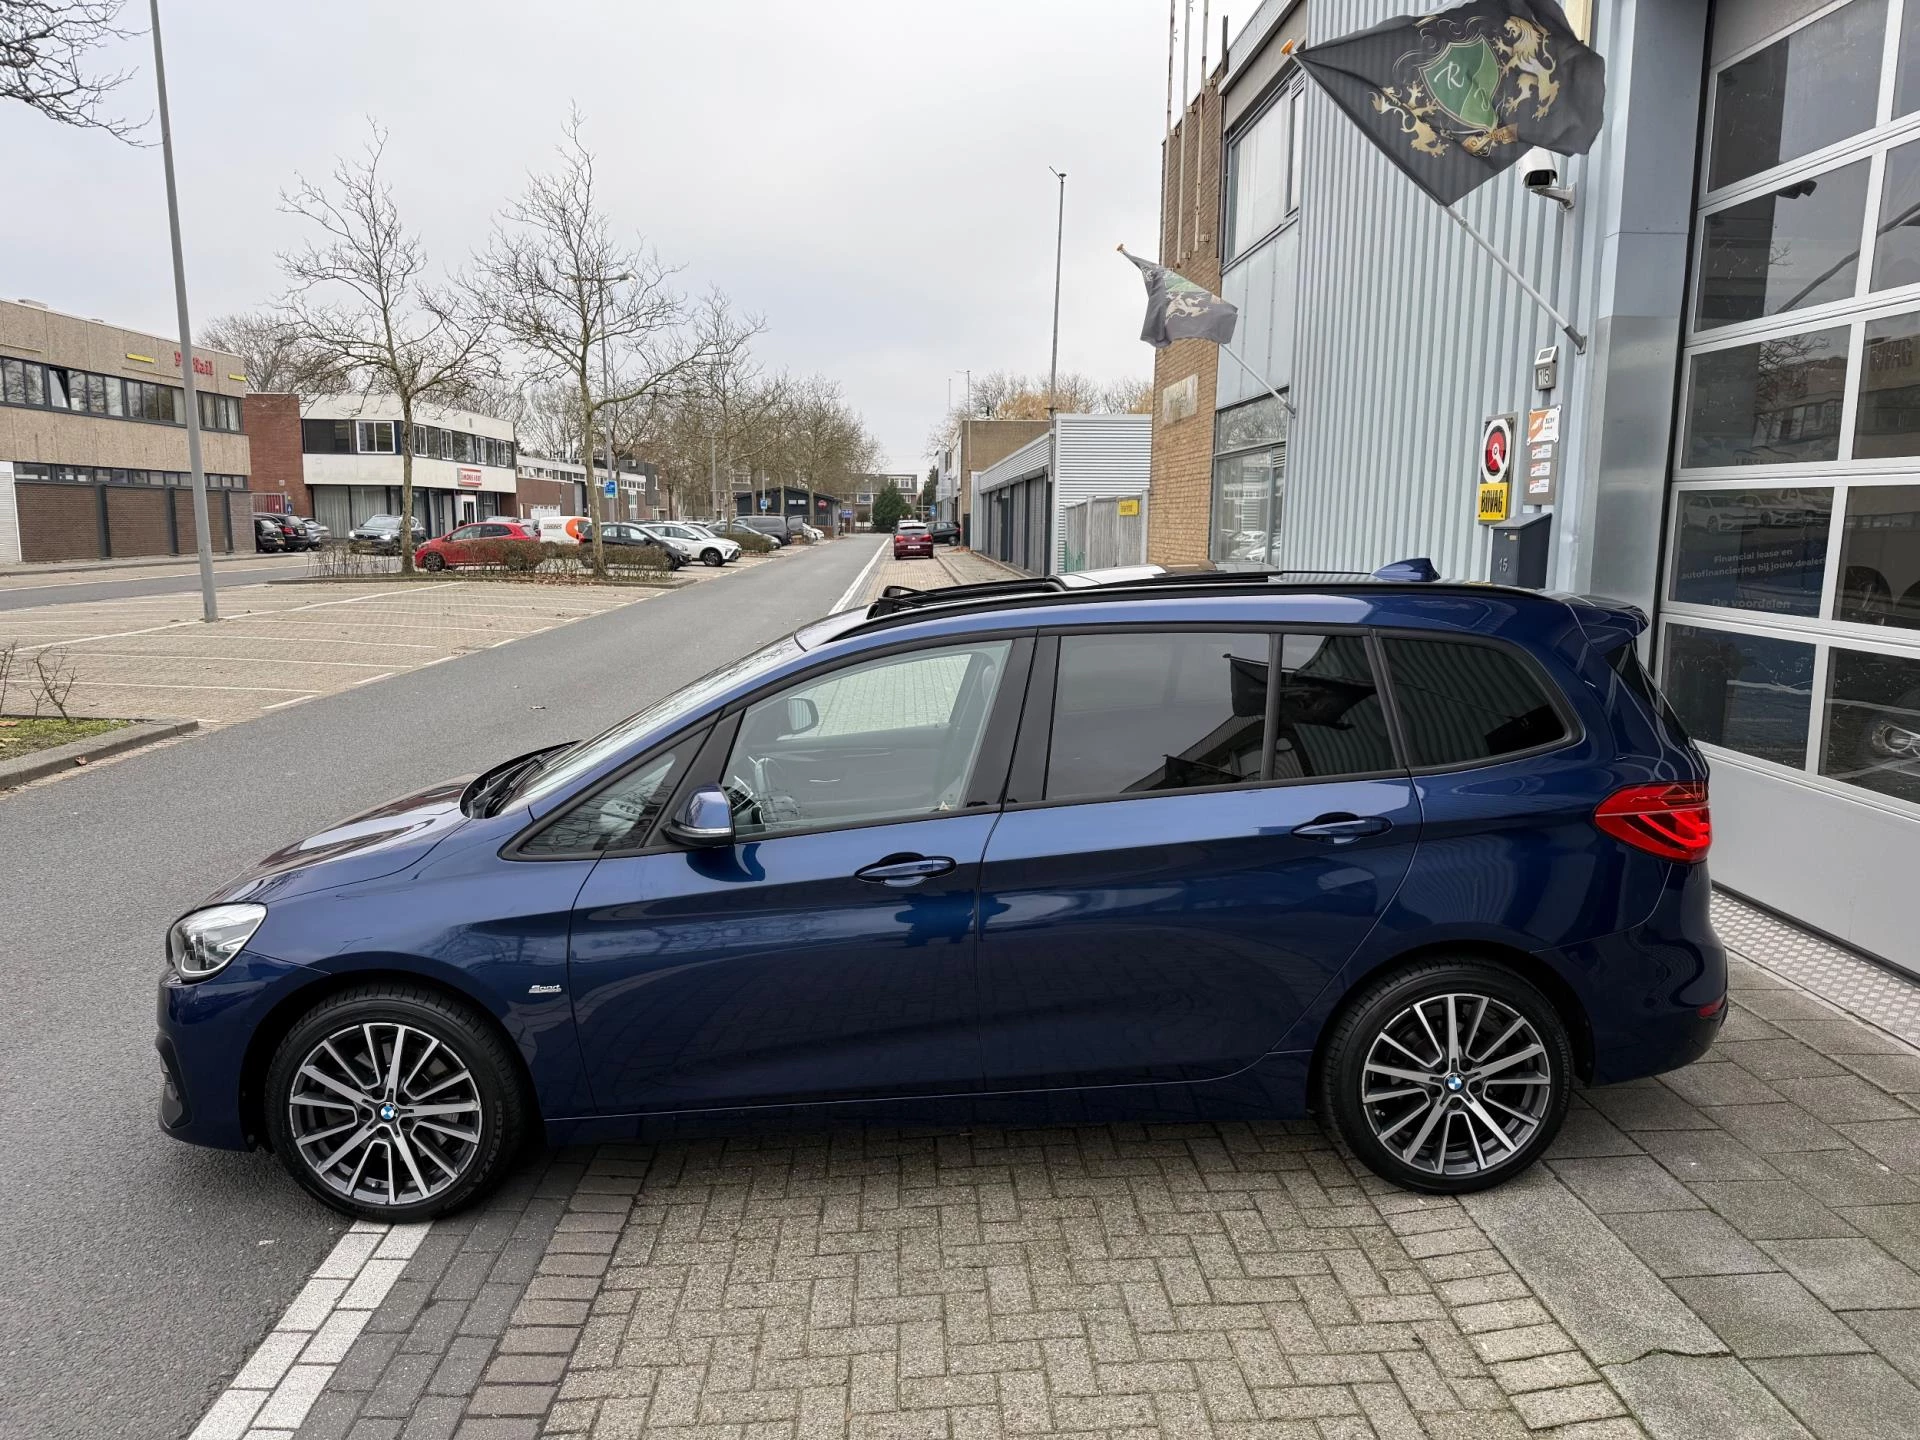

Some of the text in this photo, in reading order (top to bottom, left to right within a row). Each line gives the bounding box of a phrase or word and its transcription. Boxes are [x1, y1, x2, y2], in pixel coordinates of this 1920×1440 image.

[1481, 489, 1503, 513] BOVAG
[1714, 548, 1793, 564] Financial lease en
[1681, 564, 1756, 580] autofinanciering
[1731, 598, 1791, 610] voordelen
